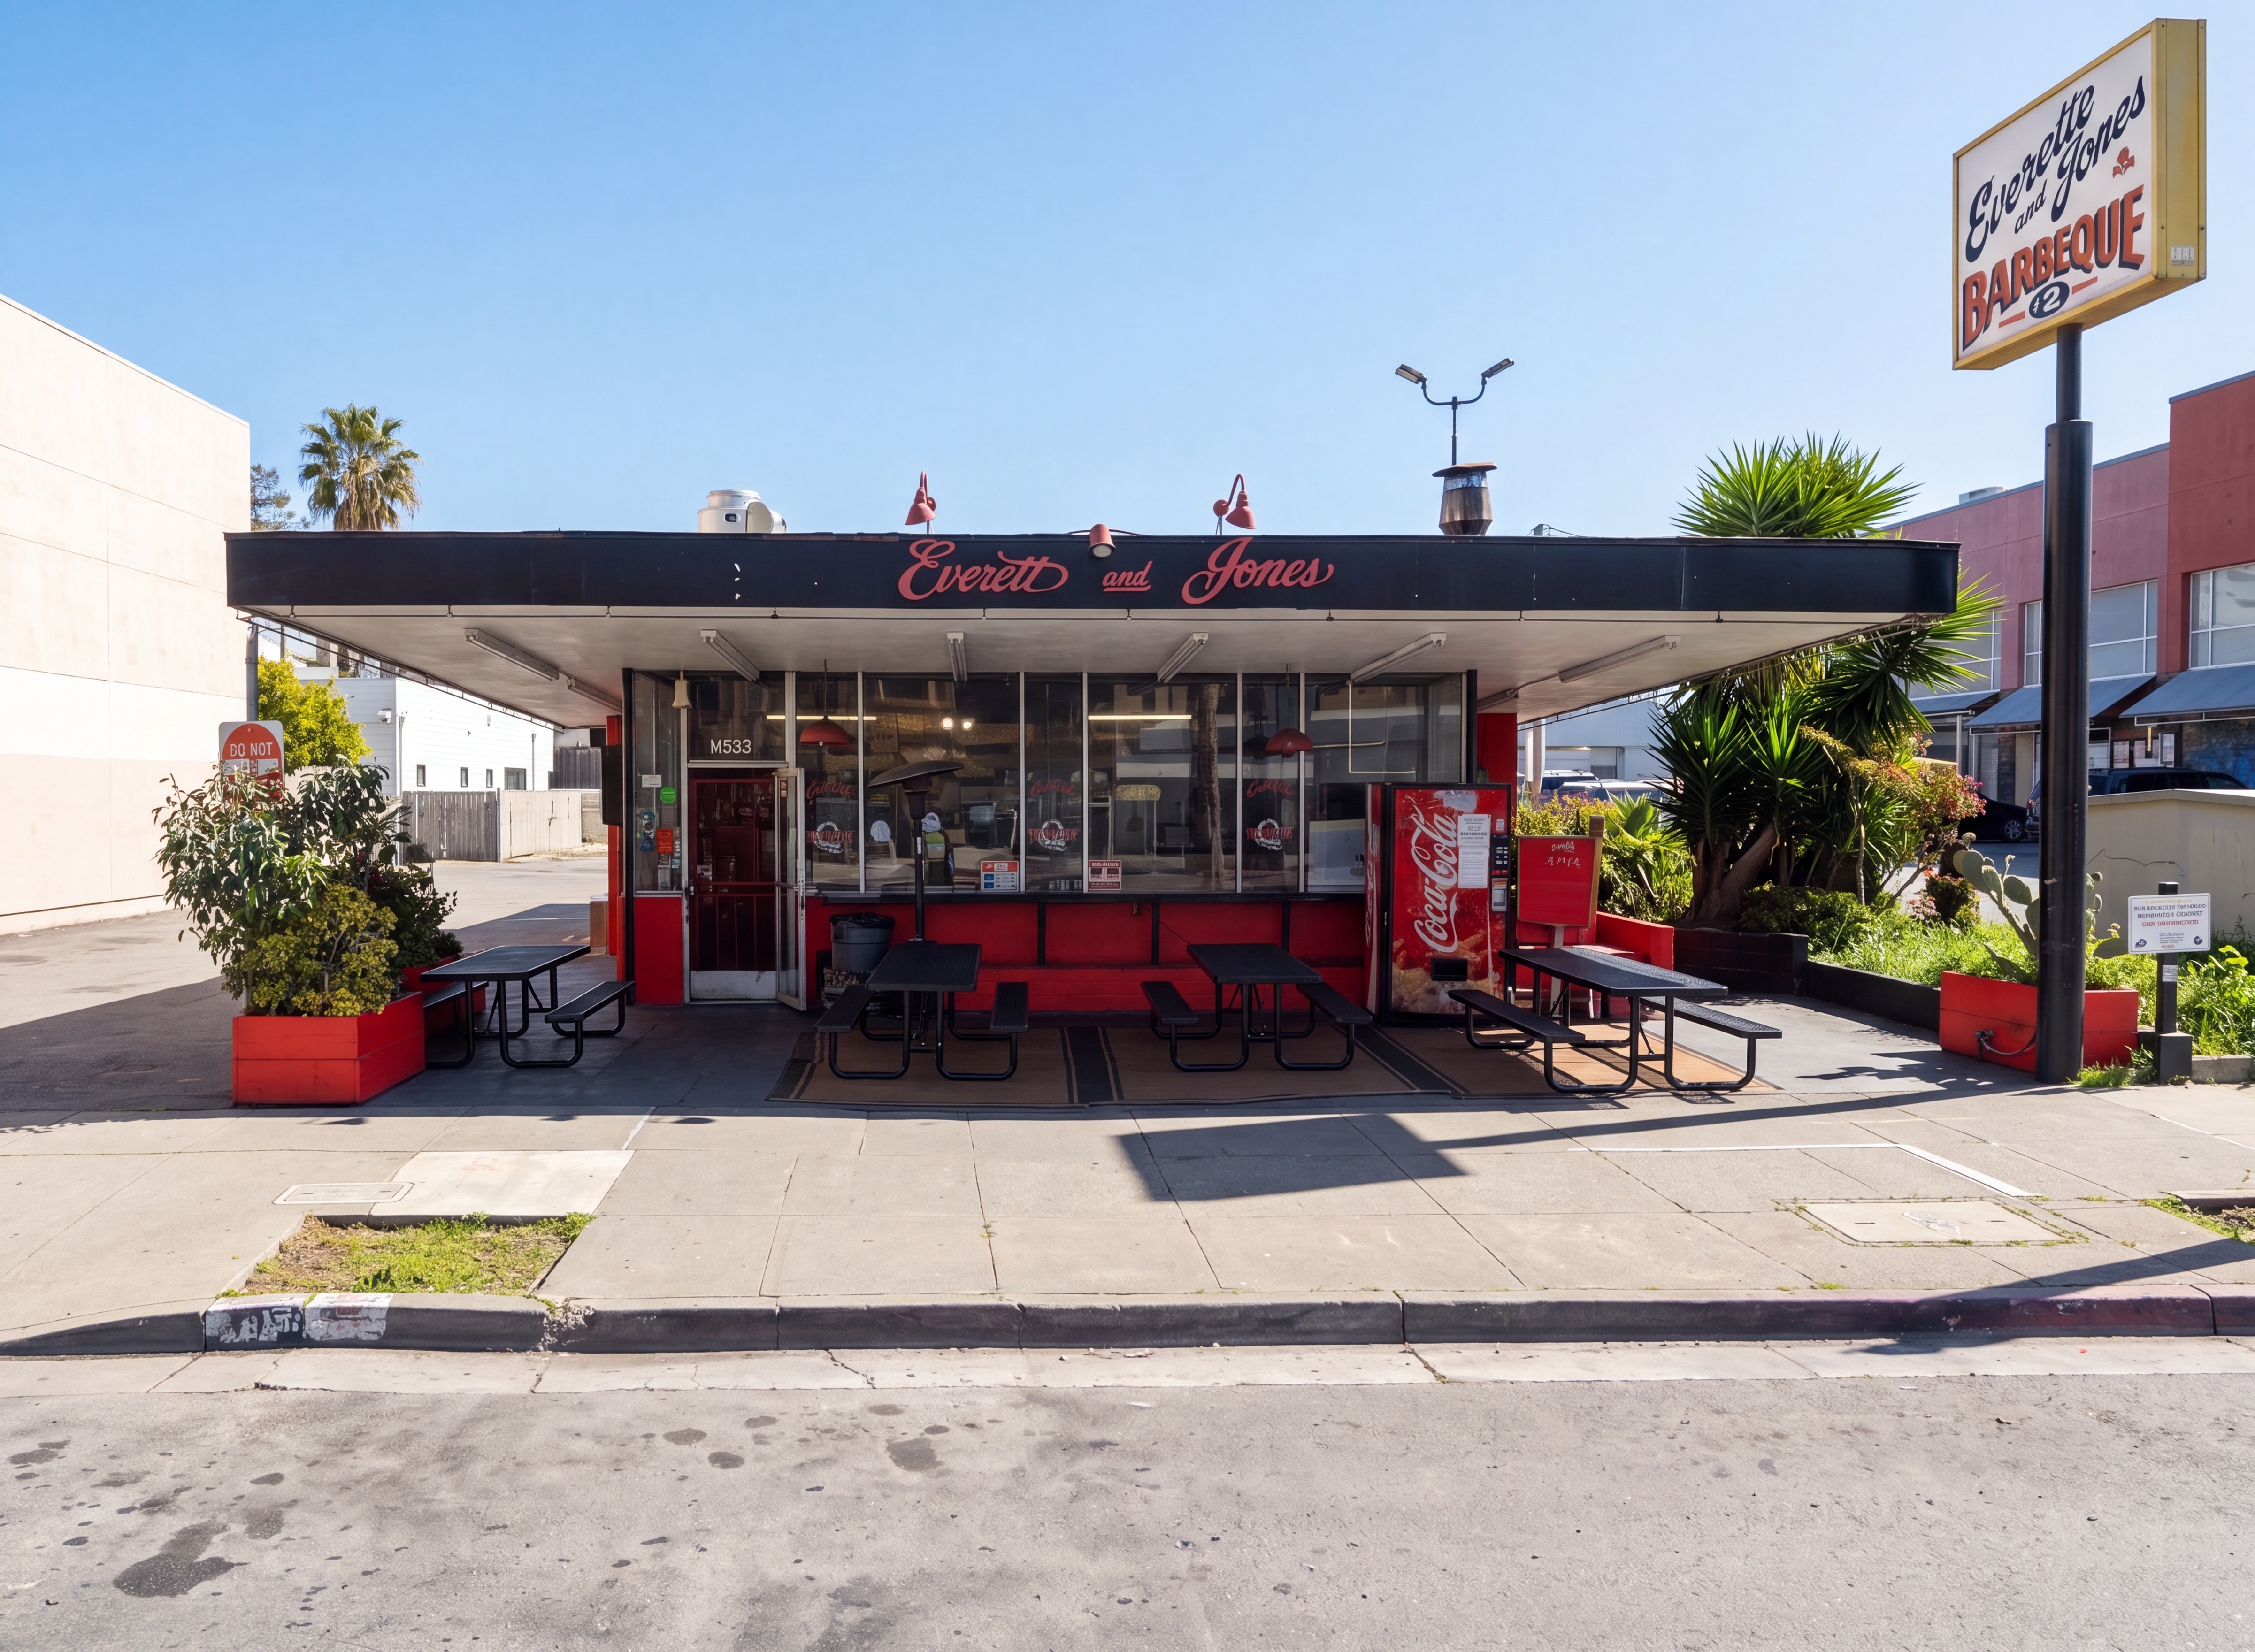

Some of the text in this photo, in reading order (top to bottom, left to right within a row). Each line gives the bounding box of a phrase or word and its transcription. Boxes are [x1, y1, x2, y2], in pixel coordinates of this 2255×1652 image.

[1965, 84, 2095, 263] Everette
[2014, 75, 2145, 234] and Jones
[1963, 184, 2145, 352] BARBEQUE
[898, 537, 1334, 604] Everett and Jones
[250, 742, 273, 756] NOT
[711, 739, 752, 754] M533
[1411, 804, 1458, 953] Coca-Cola
